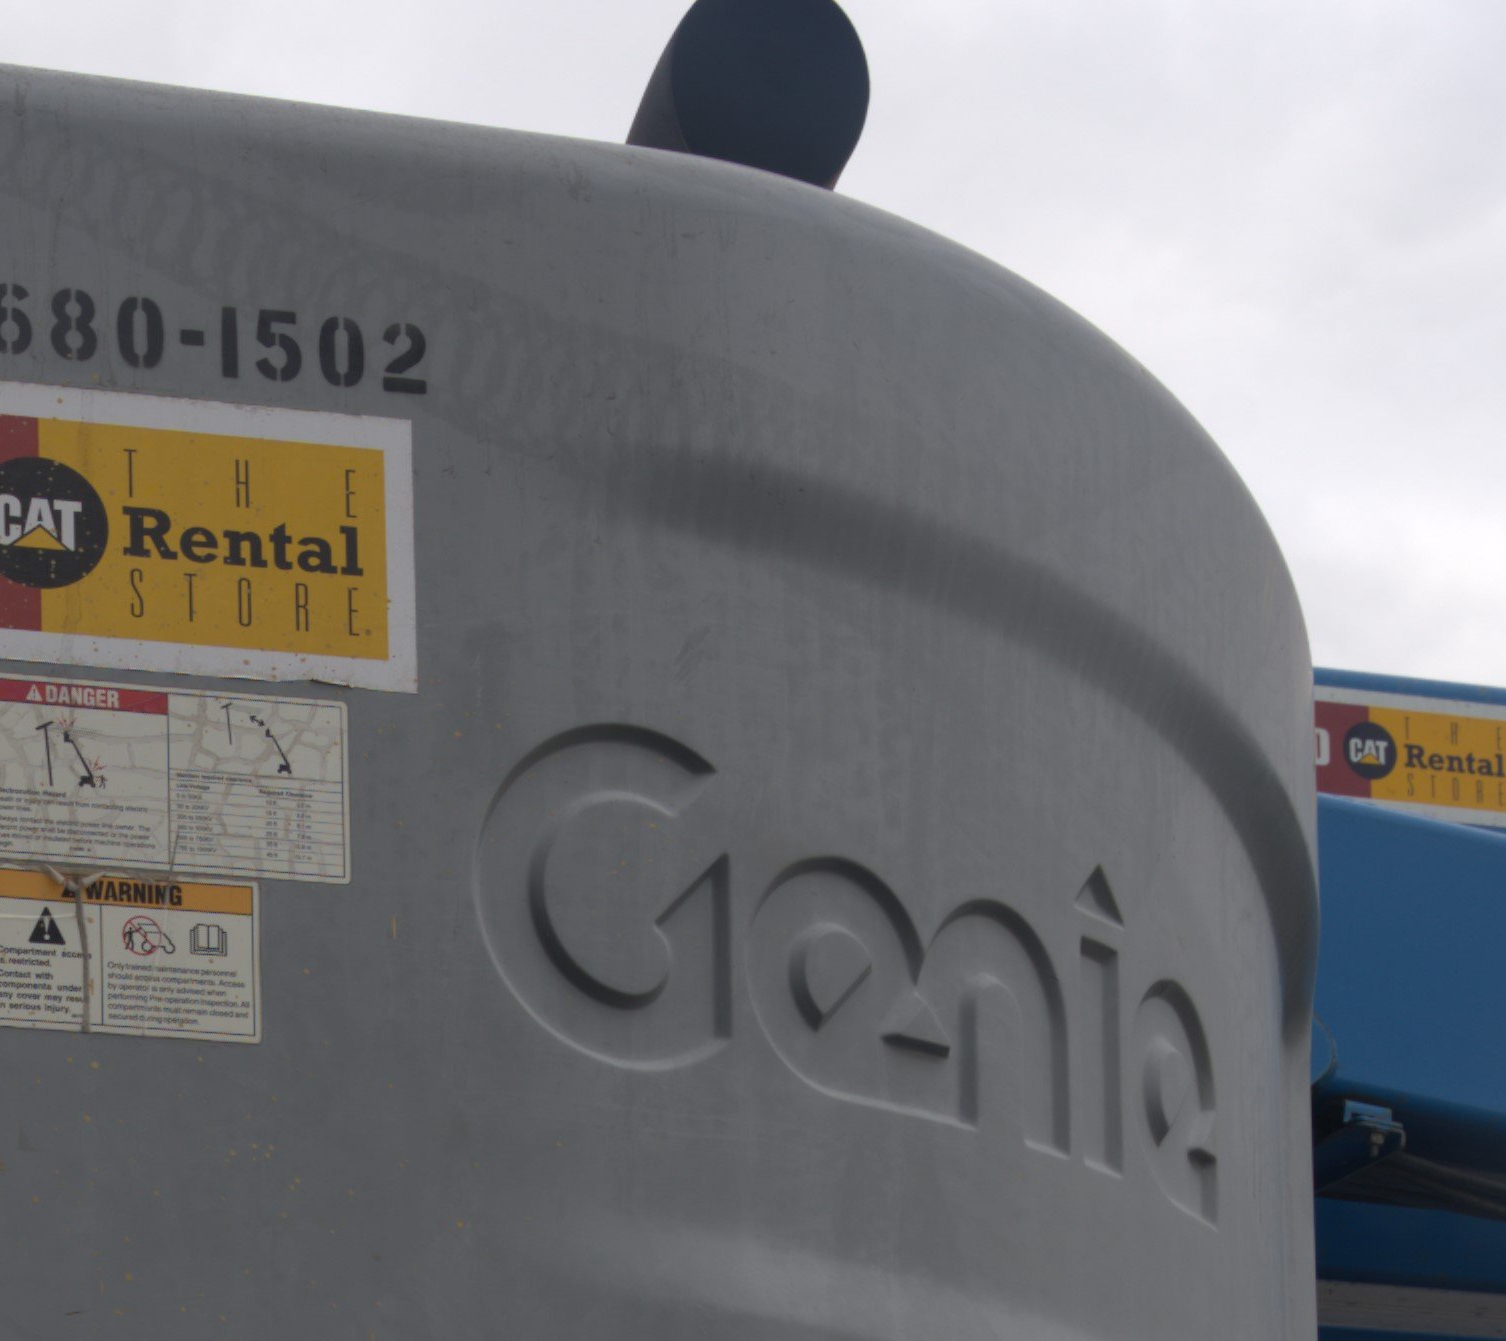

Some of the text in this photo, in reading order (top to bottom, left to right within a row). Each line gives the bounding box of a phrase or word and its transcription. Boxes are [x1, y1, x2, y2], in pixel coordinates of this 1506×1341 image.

[123, 449, 357, 518] THE
[122, 505, 364, 577] Rental
[44, 684, 120, 709] DANGER
[1404, 716, 1503, 751] THE
[1349, 737, 1388, 765] CAT
[1404, 743, 1506, 777] Rental
[86, 880, 182, 906] WARNING
[35, 971, 53, 979] with
[474, 723, 1218, 1233] Genie
